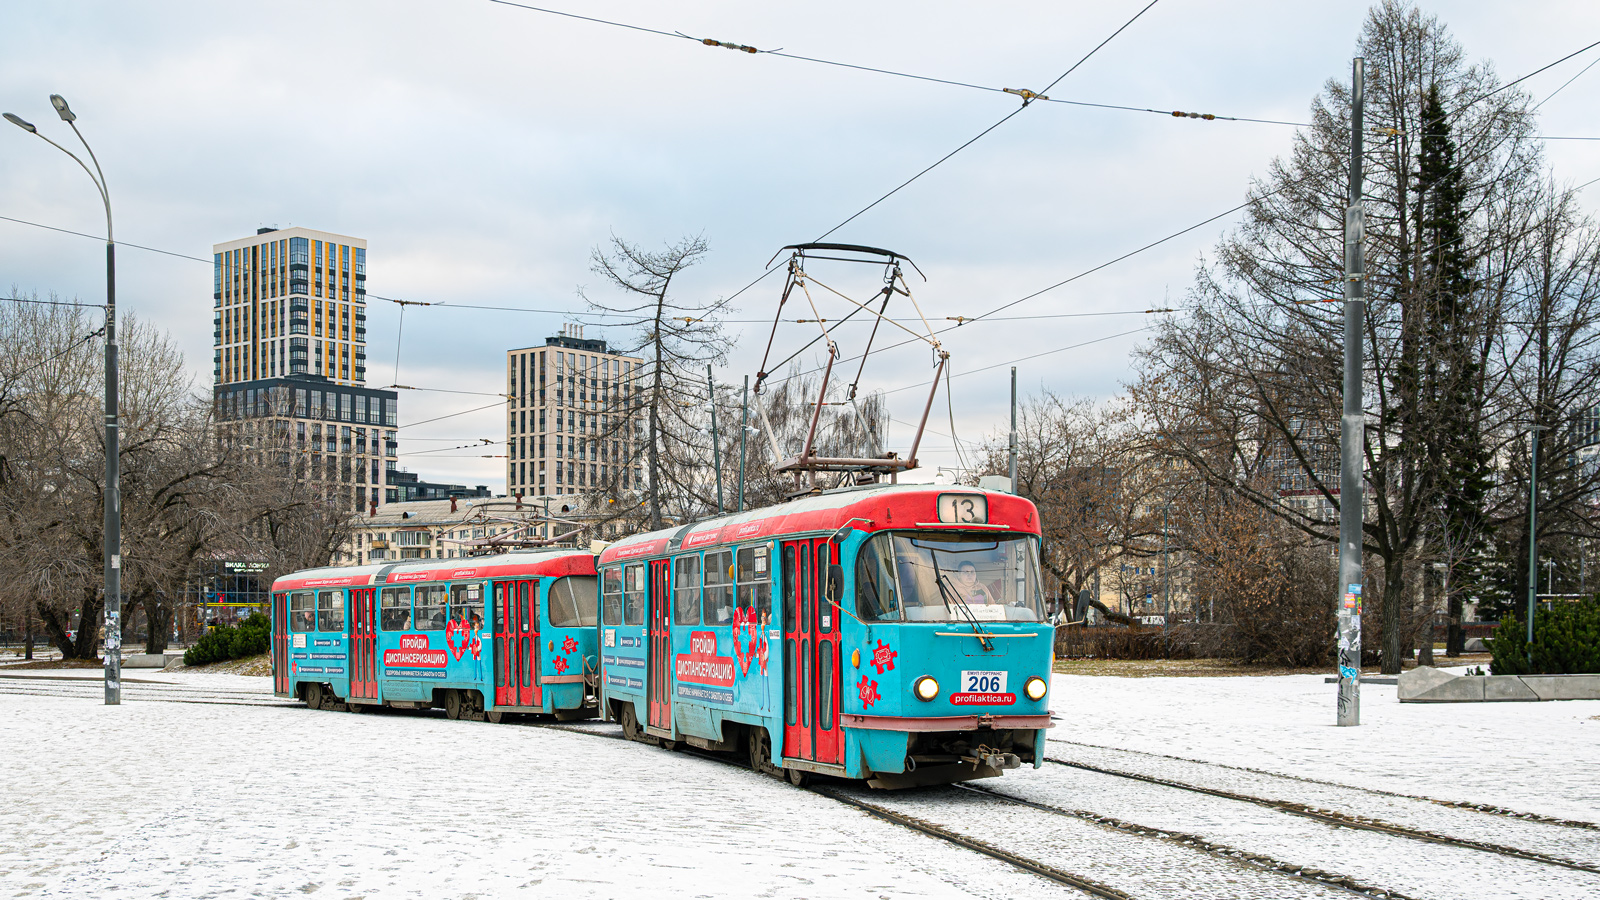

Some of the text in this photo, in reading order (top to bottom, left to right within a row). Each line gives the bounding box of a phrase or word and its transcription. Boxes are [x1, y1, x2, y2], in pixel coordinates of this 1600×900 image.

[952, 498, 975, 523] 13
[402, 636, 427, 650] ПРОЙДИ
[692, 634, 715, 656] ПРОЙДИ
[385, 653, 446, 665] ДИСПАНСЕРИЗАЦИЮ
[677, 660, 732, 682] ДИСПАНСЕРИЗАЦИЮ
[967, 676, 1000, 692] 206
[954, 694, 1012, 704] profilaktica.ru
